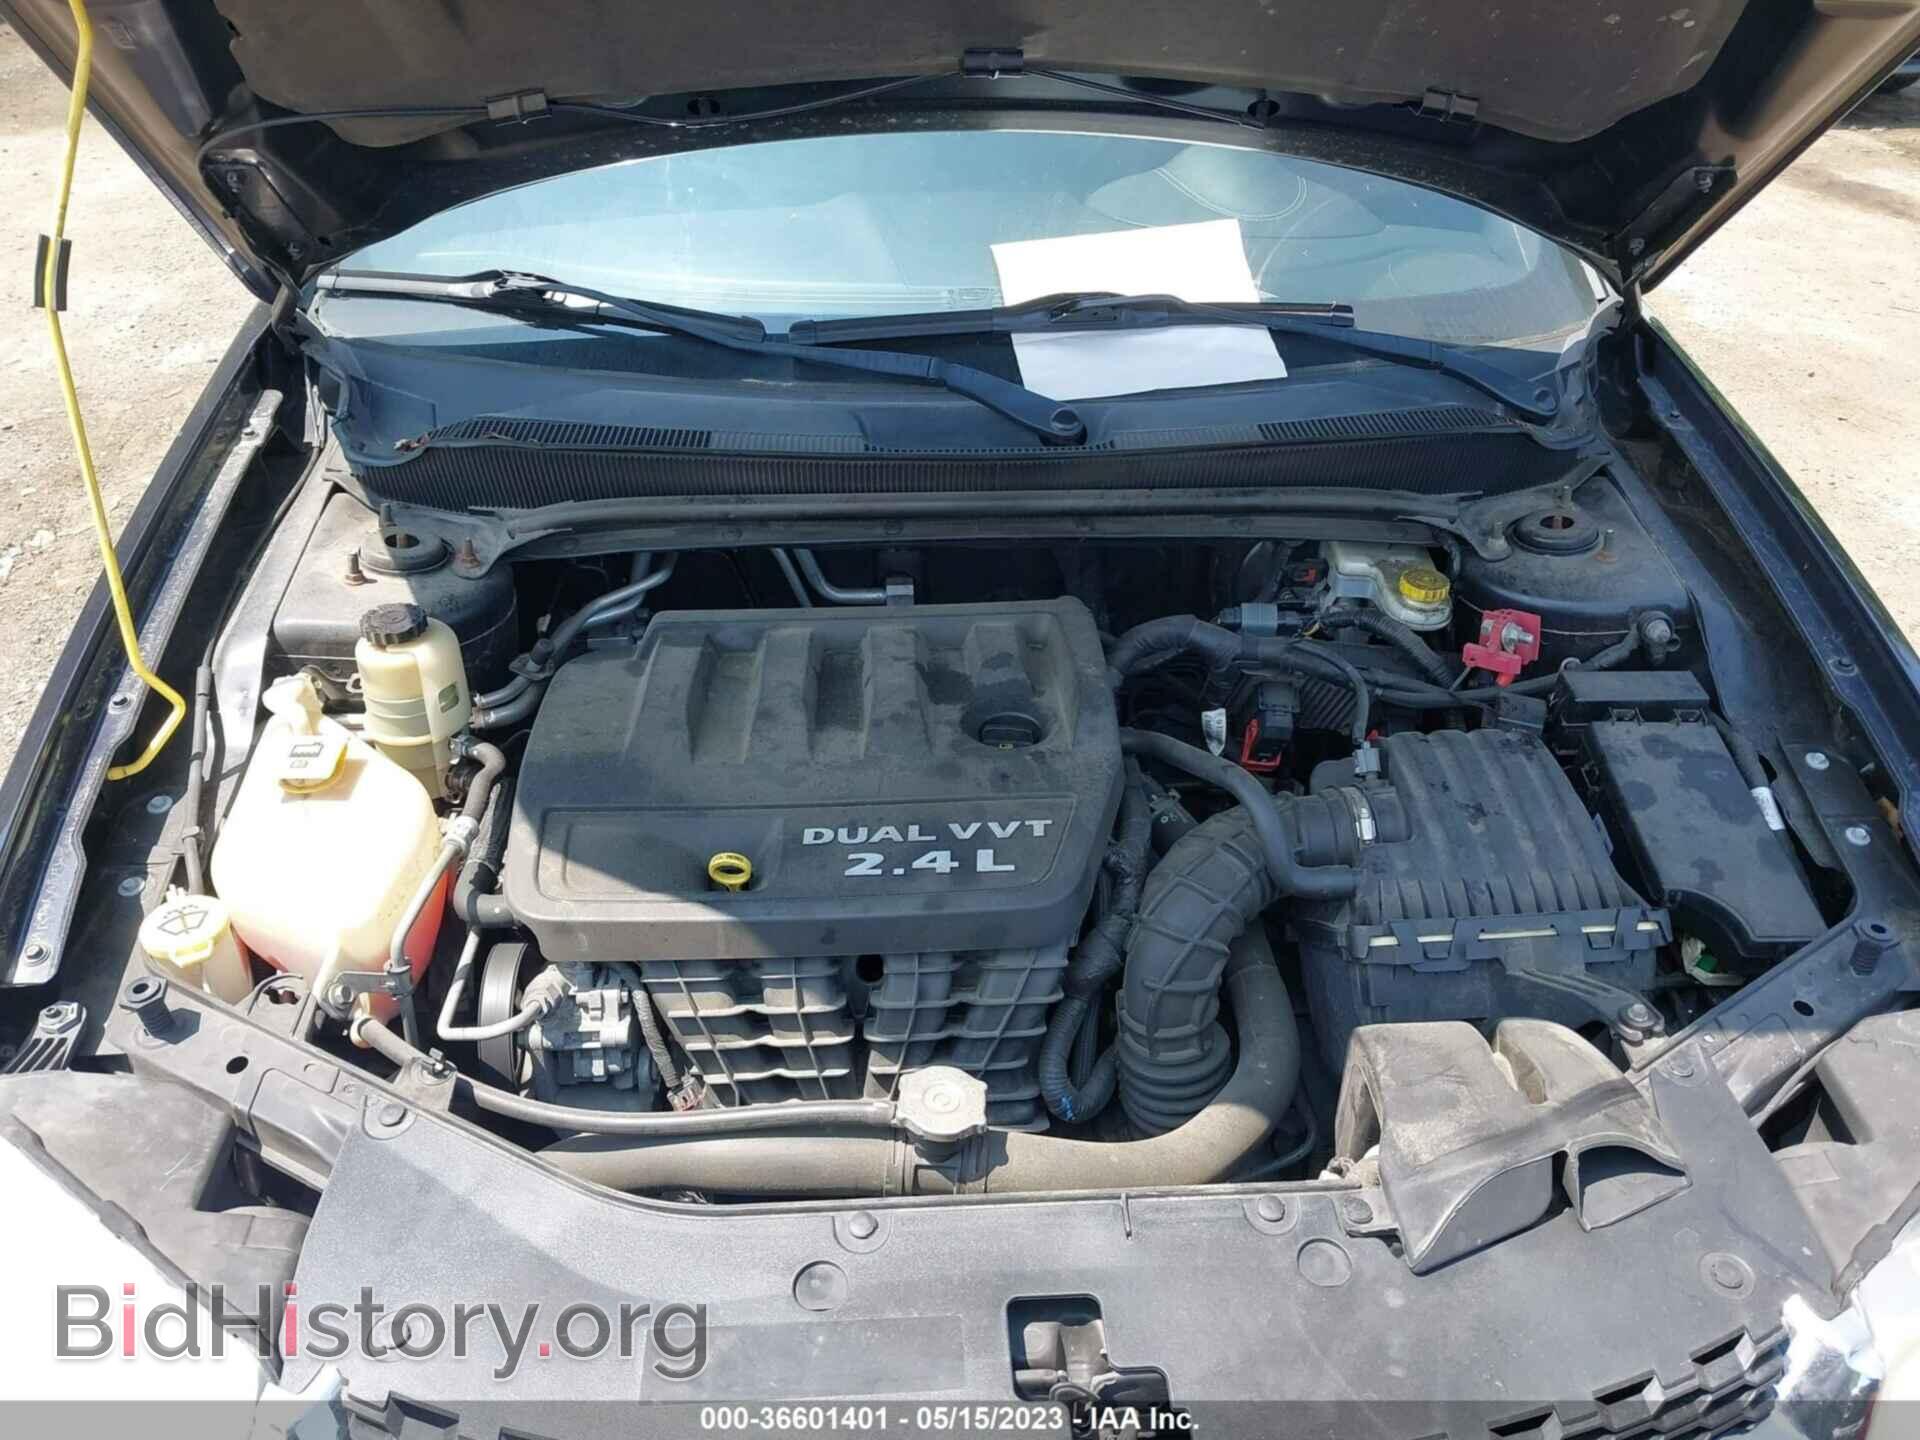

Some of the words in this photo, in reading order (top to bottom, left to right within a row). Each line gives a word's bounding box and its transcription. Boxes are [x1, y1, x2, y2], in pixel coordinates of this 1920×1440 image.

[802, 825, 937, 845] DUAL
[948, 820, 1053, 840] VVT
[844, 850, 960, 876] 2.4
[976, 849, 1016, 873] L
